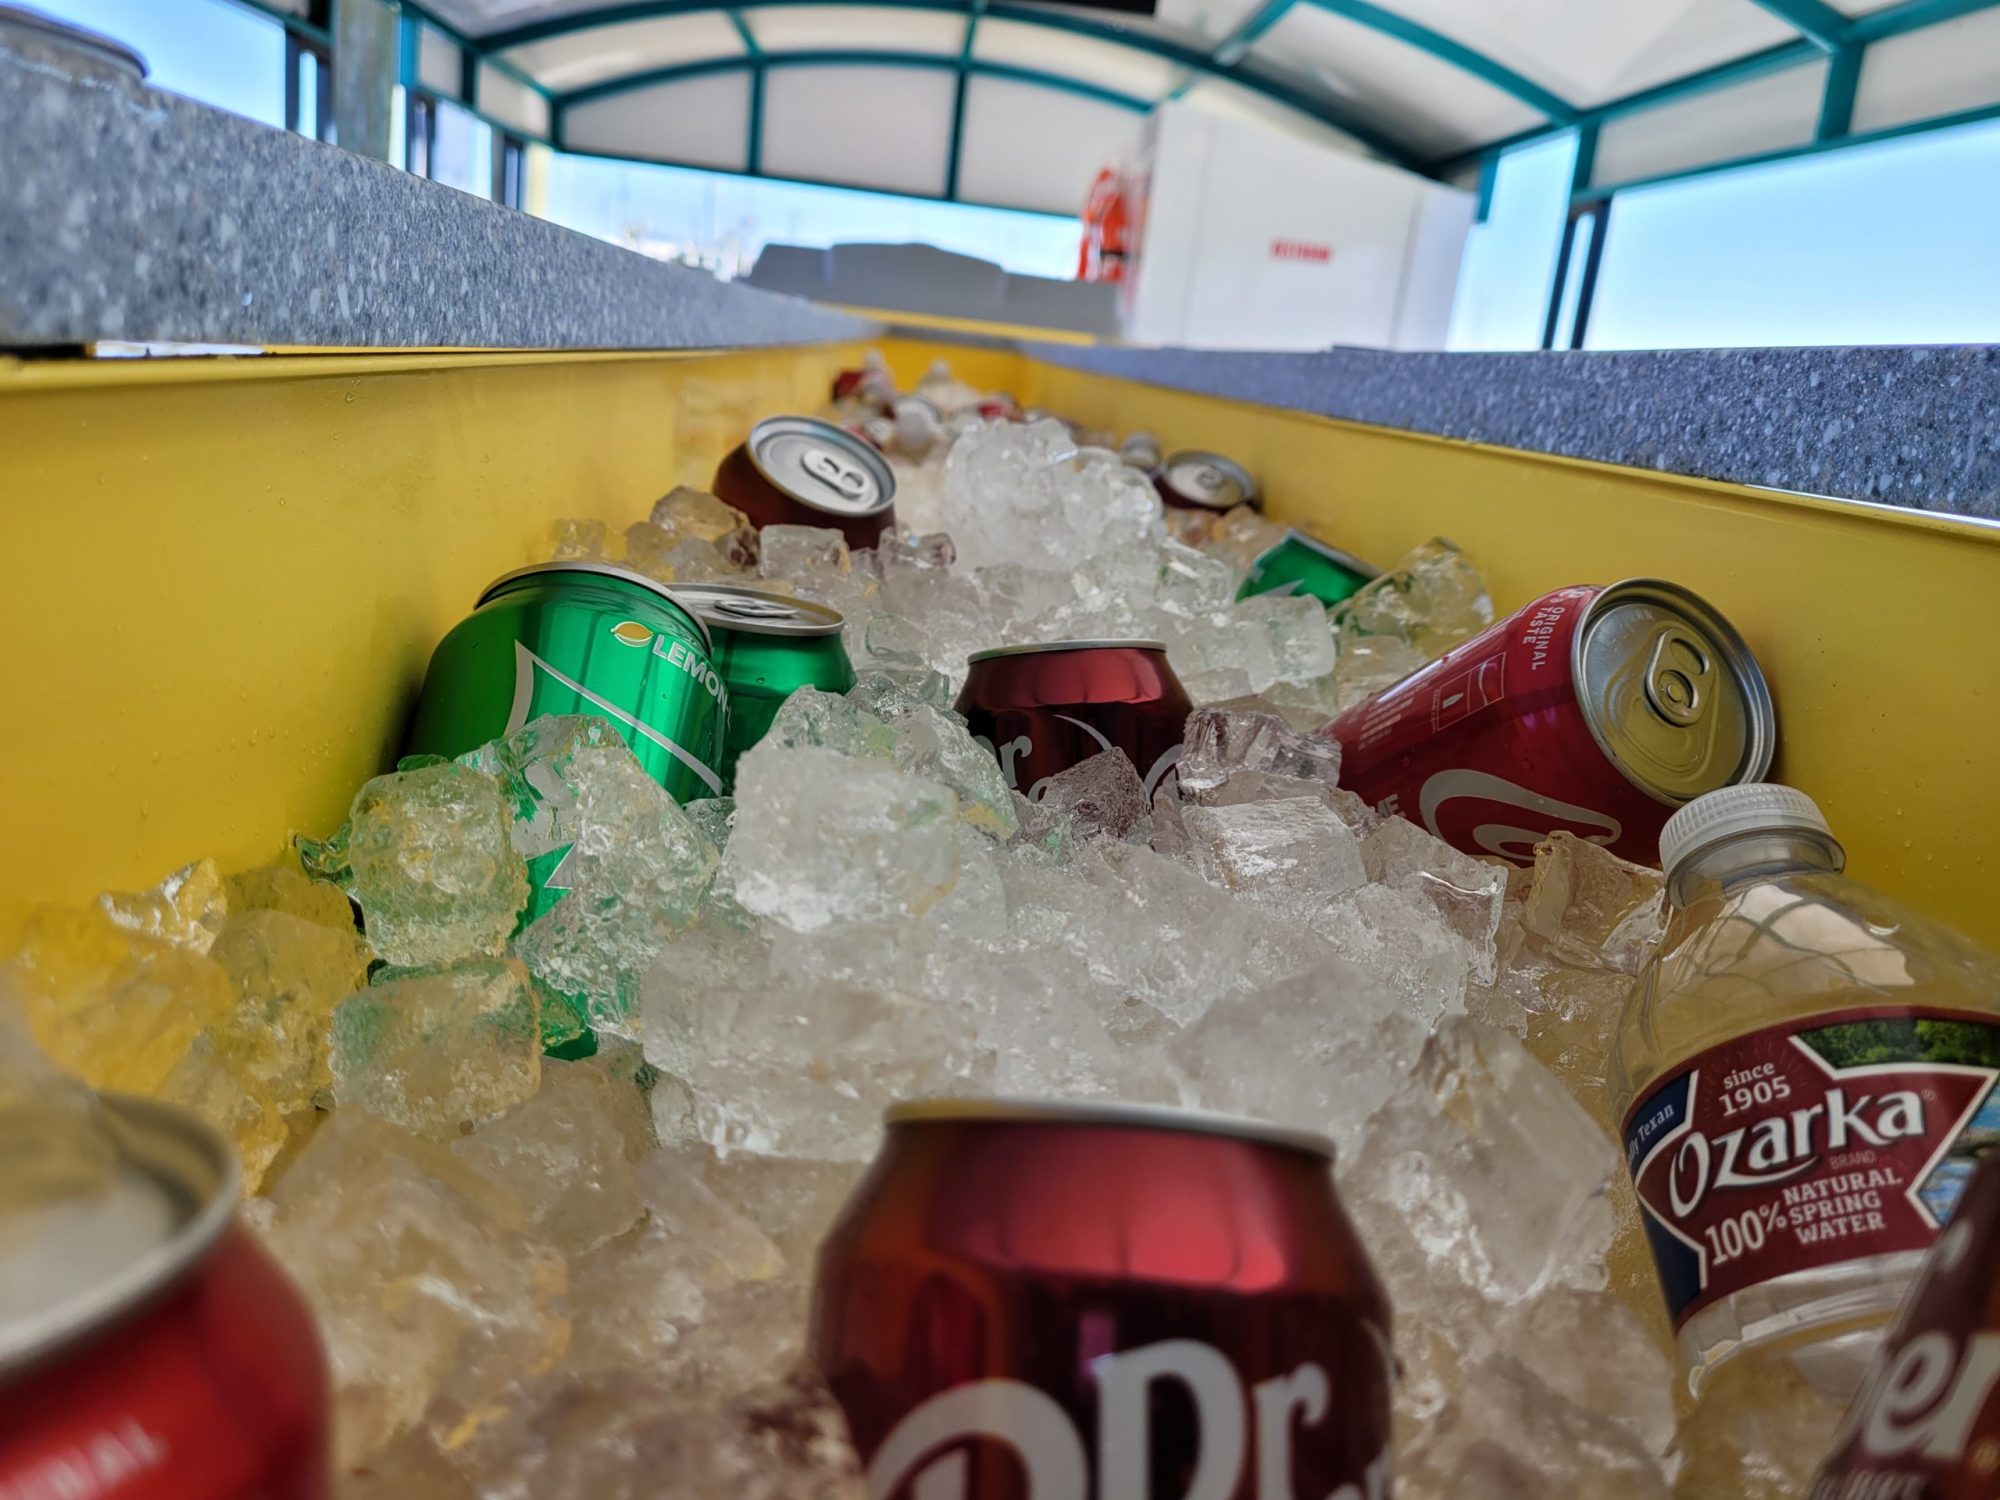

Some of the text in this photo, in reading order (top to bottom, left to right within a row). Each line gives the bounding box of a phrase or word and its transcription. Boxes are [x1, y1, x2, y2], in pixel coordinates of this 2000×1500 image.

[1522, 606, 1555, 645] TASTE
[1531, 606, 1566, 671] ORIGINAL
[652, 634, 728, 713] LEMON
[1723, 1062, 1776, 1090] since
[1718, 1075, 1791, 1118] 1905
[1637, 1103, 1675, 1143] Texan
[1669, 1087, 1926, 1218] Ozarka
[1829, 1150, 1876, 1170] BRAND
[1782, 1167, 1903, 1207] NATURAL
[1788, 1190, 1882, 1226] SPRING
[1795, 1211, 1886, 1245] WATER
[1704, 1200, 1787, 1267] 100%
